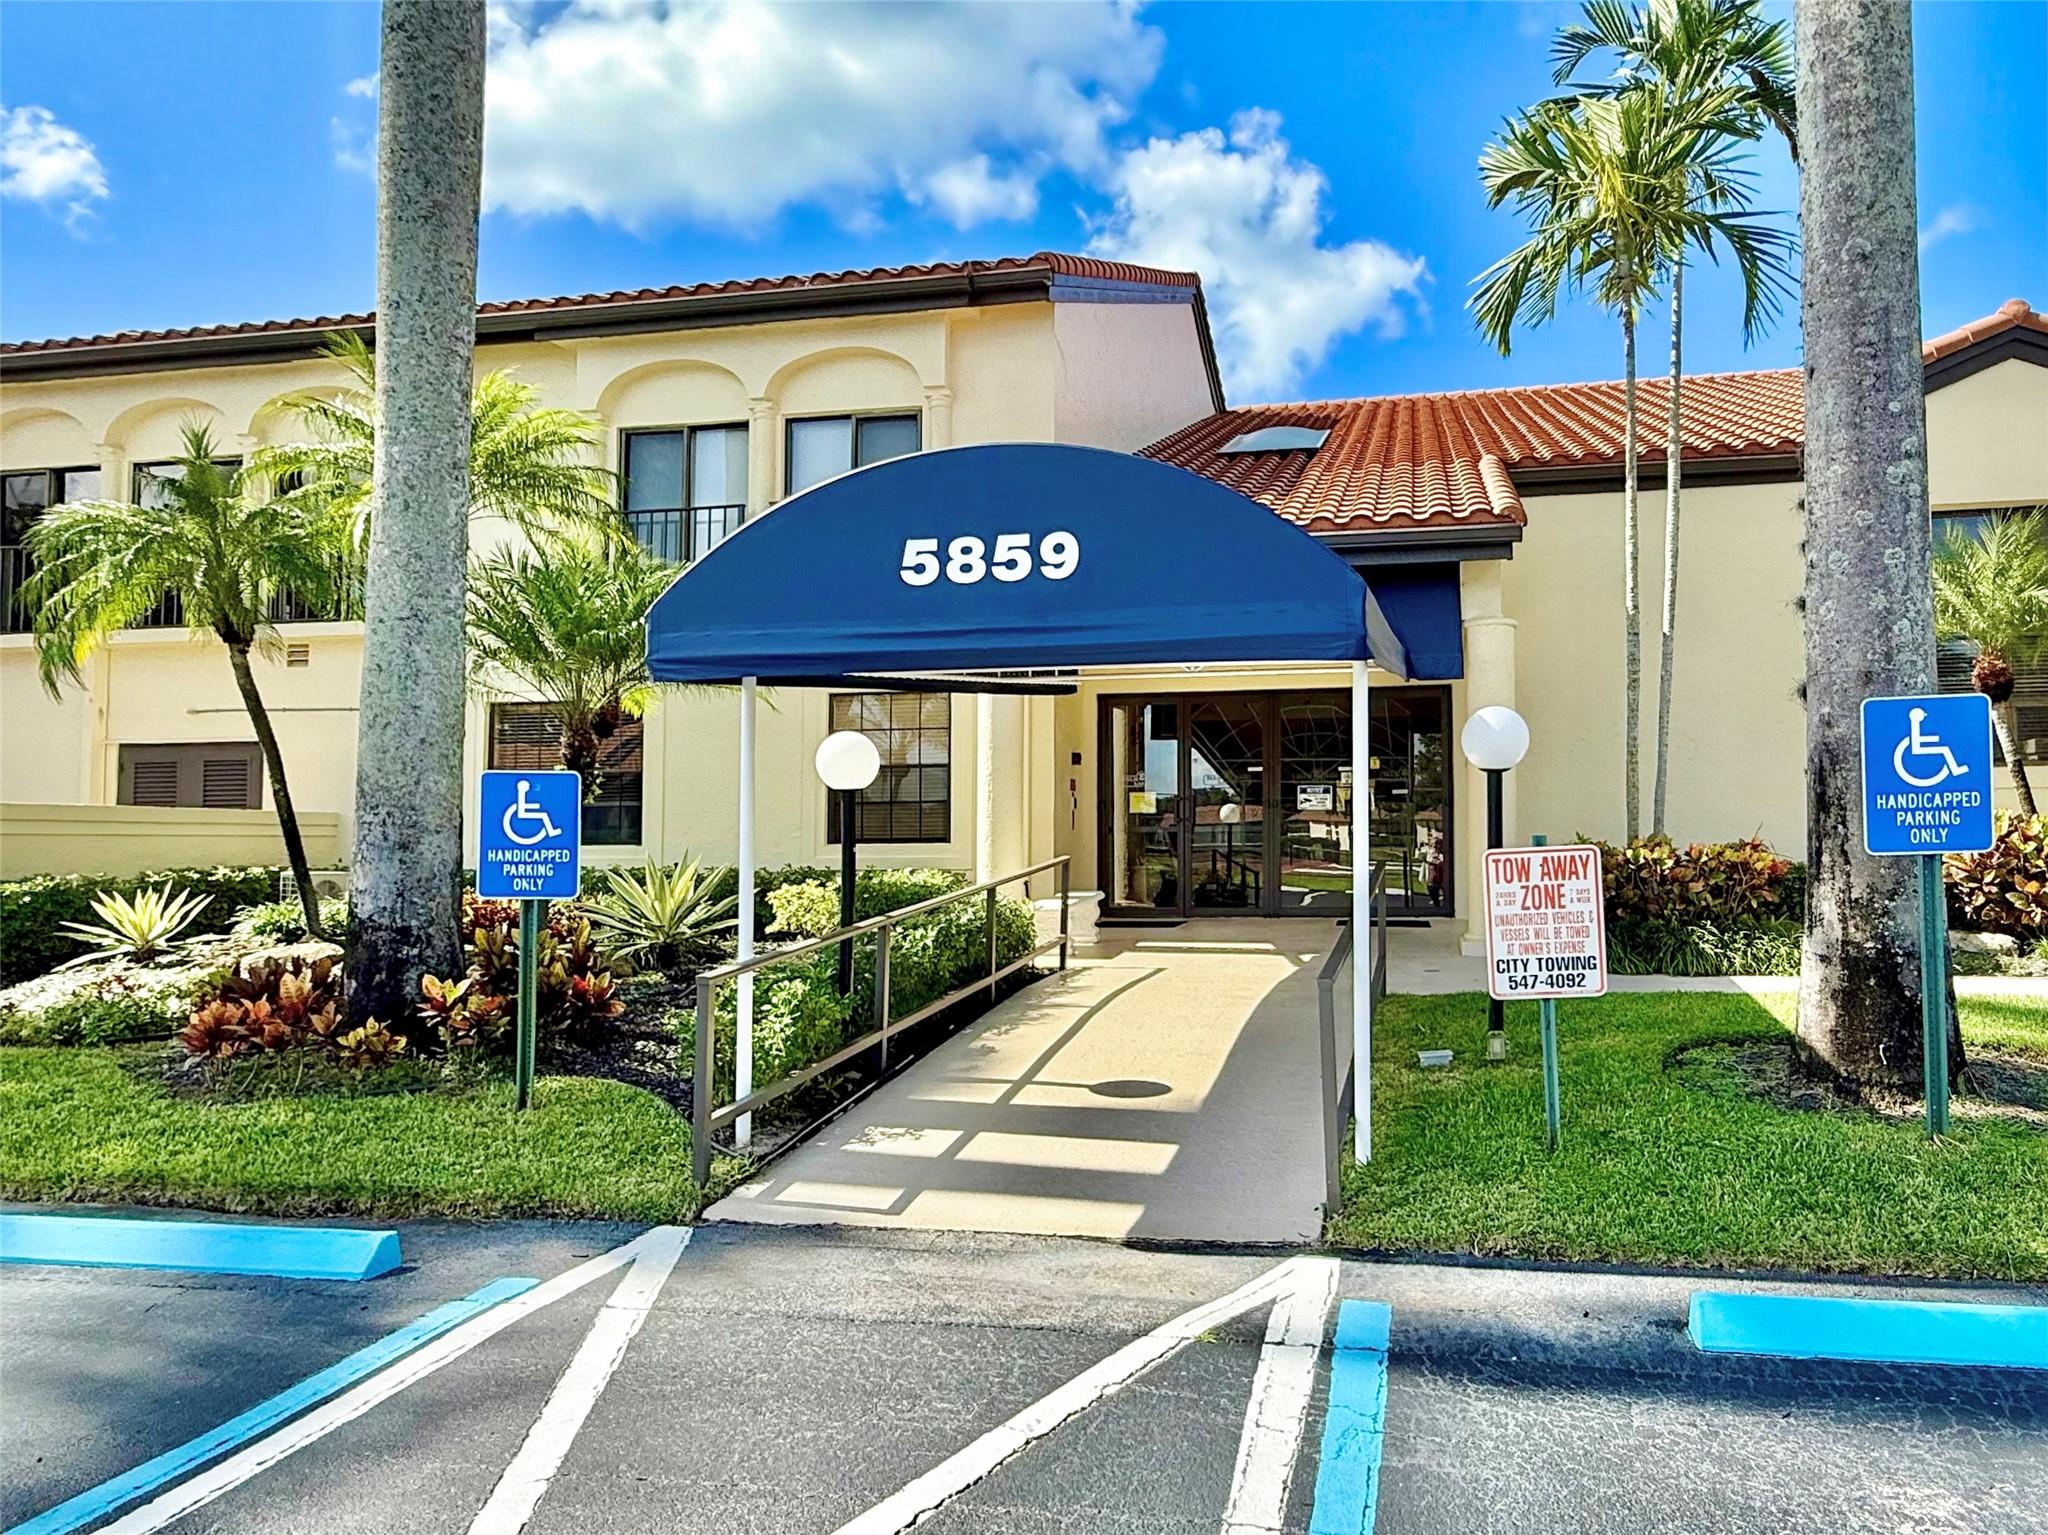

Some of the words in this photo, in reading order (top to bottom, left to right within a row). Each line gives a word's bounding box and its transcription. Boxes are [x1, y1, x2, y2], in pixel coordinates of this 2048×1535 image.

[900, 531, 1079, 586] 5859
[1876, 791, 1981, 809] HANDICAPPED
[1896, 809, 1961, 826] PARKING
[1910, 828, 1949, 844] ONLY
[487, 849, 571, 862] HANDICAPPED
[503, 864, 554, 876] PARKING
[1492, 857, 1531, 884] TOW
[1541, 854, 1590, 881] AWAY
[513, 878, 544, 891] ONLY
[1520, 883, 1567, 911] ZONE
[1495, 912, 1548, 927] UNAUTHORIZED
[1552, 911, 1585, 924] VEHICLES
[1500, 928, 1530, 941] VESSELS
[1534, 927, 1550, 940] WILL
[1553, 927, 1563, 939] BE
[1566, 926, 1590, 938] TOWED
[1507, 943, 1515, 956] AT
[1554, 941, 1586, 954] EXPENSE
[1496, 958, 1530, 974] CITY
[1536, 956, 1597, 972] TOWING
[1508, 973, 1586, 990] 547-4092
